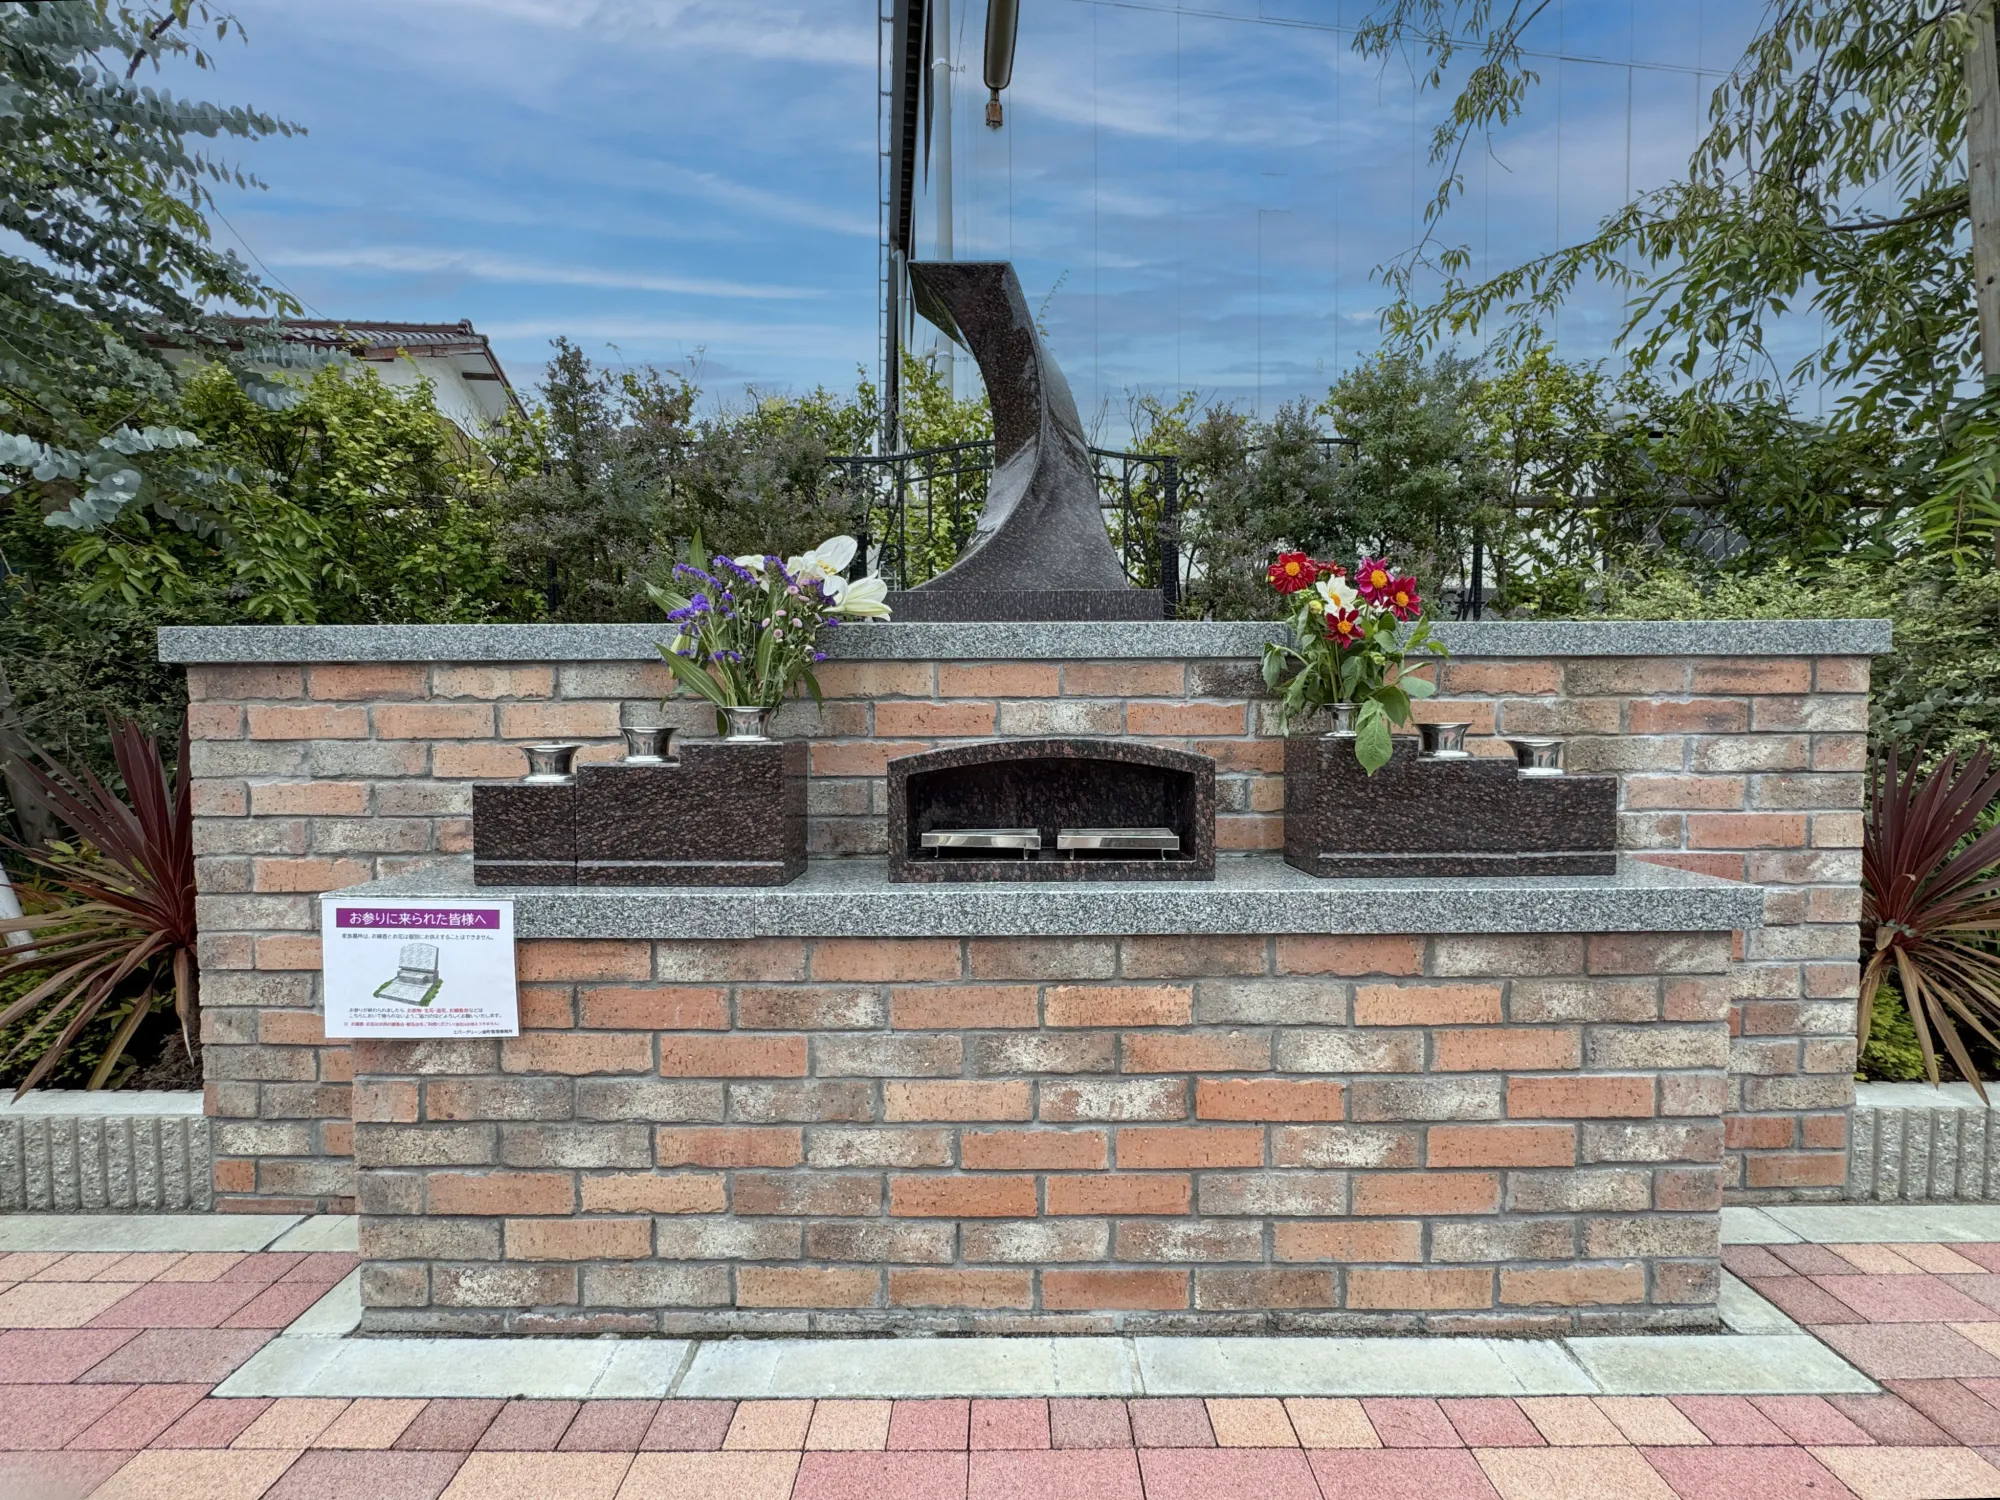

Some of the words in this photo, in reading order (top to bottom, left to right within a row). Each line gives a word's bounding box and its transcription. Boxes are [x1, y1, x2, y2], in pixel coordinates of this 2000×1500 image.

[349, 912, 487, 927] お参りに来られた皆様へ
